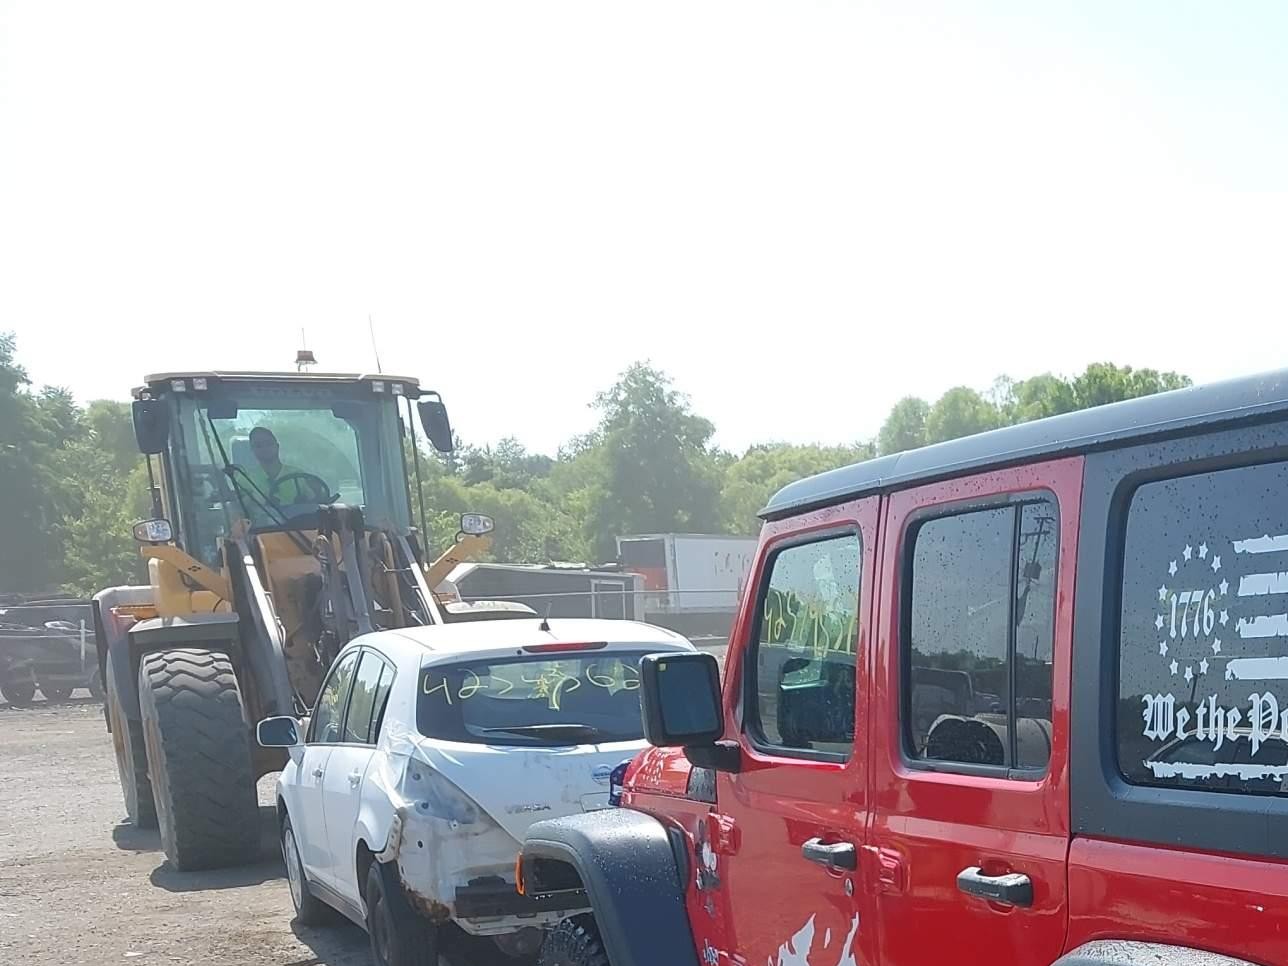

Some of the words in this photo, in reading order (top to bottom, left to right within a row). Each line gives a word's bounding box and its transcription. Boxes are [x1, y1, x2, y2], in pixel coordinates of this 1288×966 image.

[1168, 588, 1215, 639] 1776
[1142, 692, 1191, 742] We
[1195, 693, 1243, 752] the
